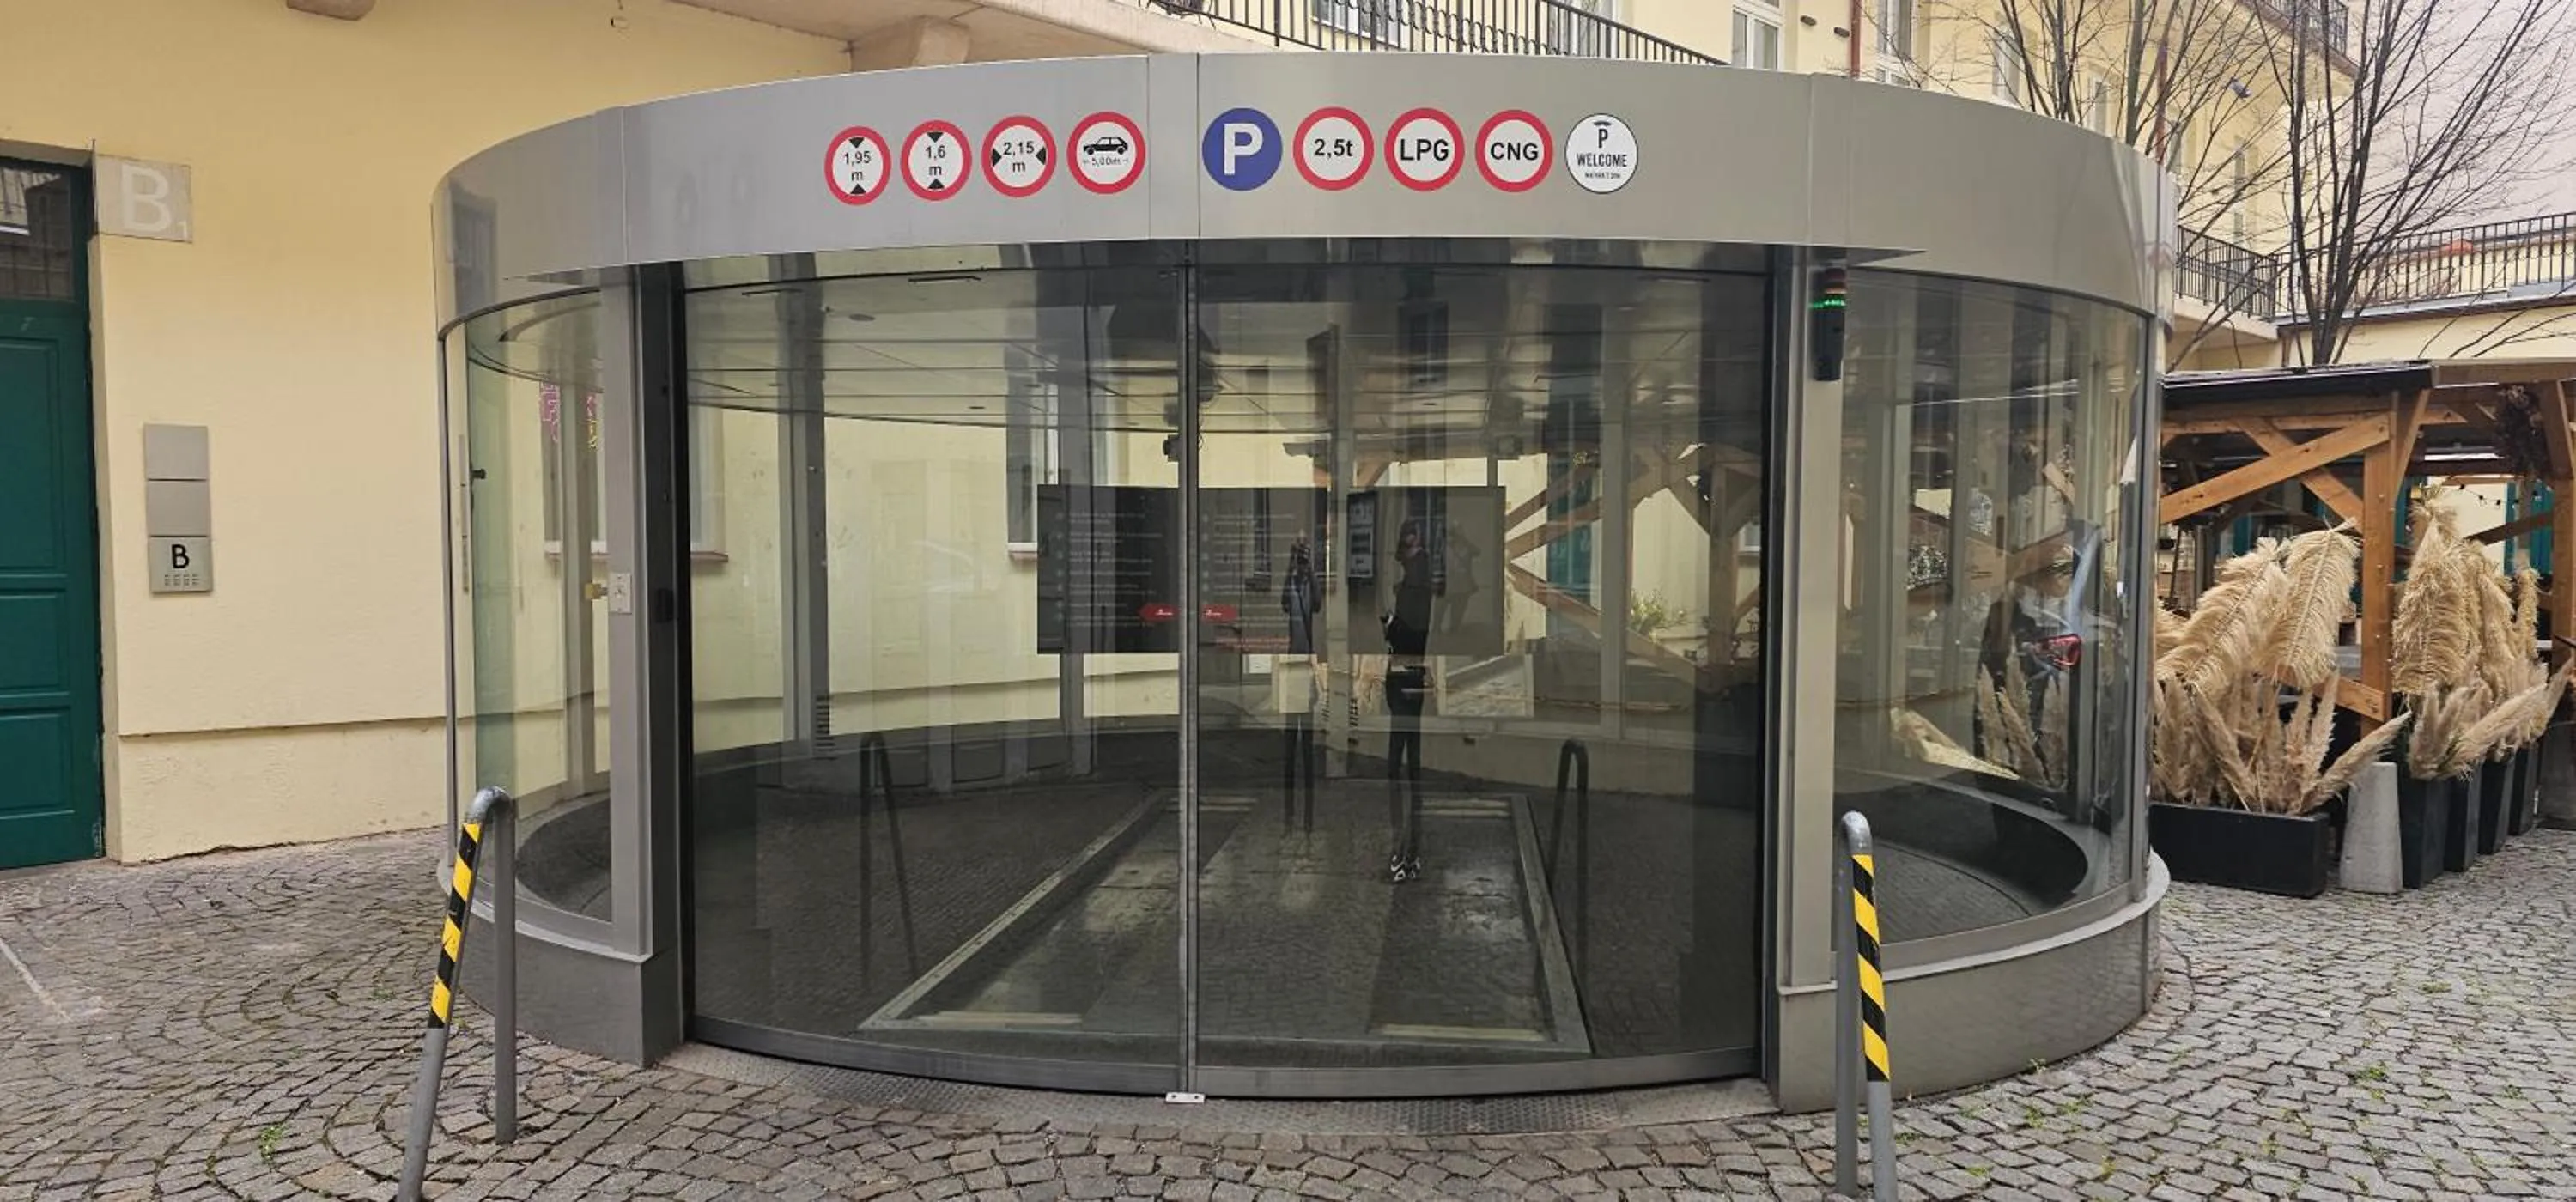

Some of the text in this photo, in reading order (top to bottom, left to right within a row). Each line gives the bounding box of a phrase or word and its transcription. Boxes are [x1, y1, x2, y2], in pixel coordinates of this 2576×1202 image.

[1598, 128, 1609, 149] P
[926, 145, 946, 161] 1,6
[1003, 140, 1035, 156] 2,15
[1224, 123, 1264, 176] P
[1314, 138, 1354, 158] 2,5t
[1400, 138, 1449, 161] LPG
[1490, 142, 1539, 161] CNG
[844, 150, 872, 167] 1,95
[1012, 161, 1026, 173] m
[1576, 153, 1628, 167] WELCOME
[851, 170, 864, 181] m
[929, 165, 943, 176] m
[172, 543, 190, 568] B
